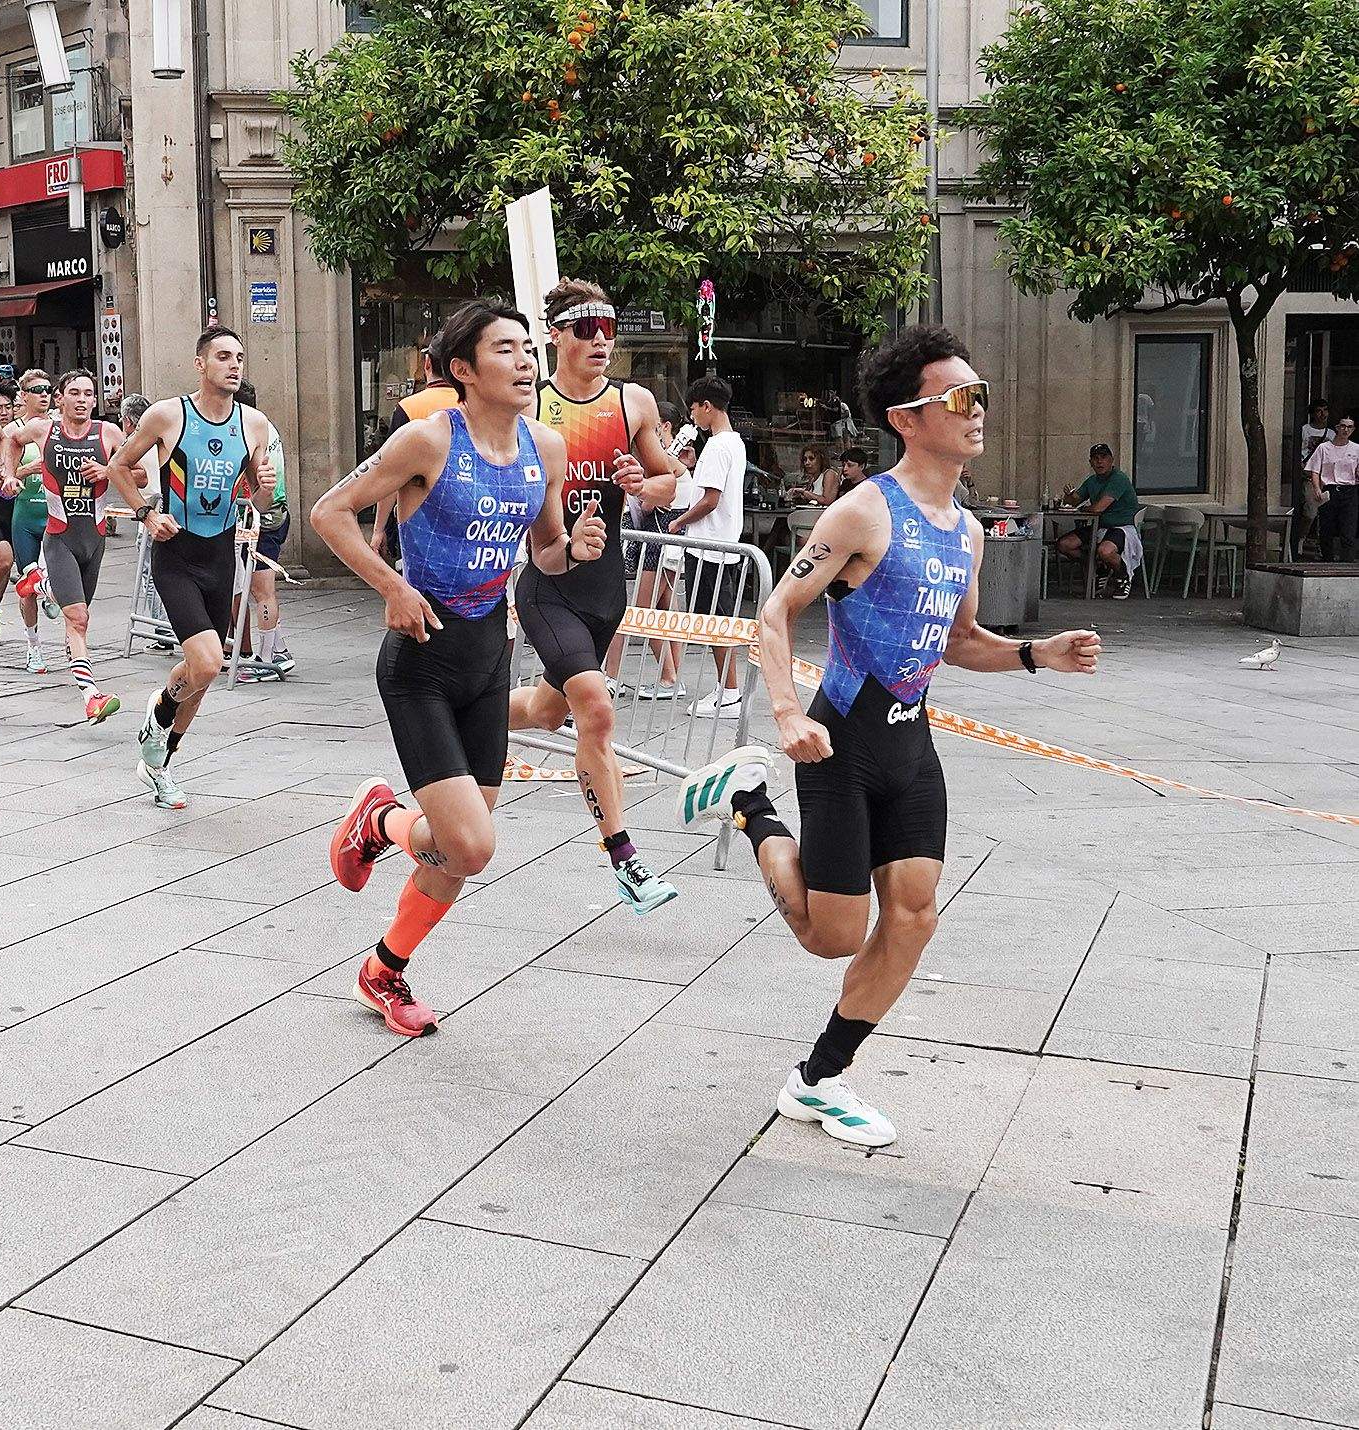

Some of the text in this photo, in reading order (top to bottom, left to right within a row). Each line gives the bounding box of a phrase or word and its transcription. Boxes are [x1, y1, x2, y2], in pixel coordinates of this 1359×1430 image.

[47, 161, 69, 184] FRO
[47, 258, 87, 277] MARCO
[195, 458, 234, 476] VAES
[565, 461, 610, 482] NOLL
[194, 475, 229, 491] BEL
[498, 501, 528, 516] NTT
[466, 520, 523, 542] OKADA
[467, 547, 509, 570] JPN
[791, 559, 814, 578] 9
[944, 567, 967, 584] NTT
[911, 623, 950, 653] JPN
